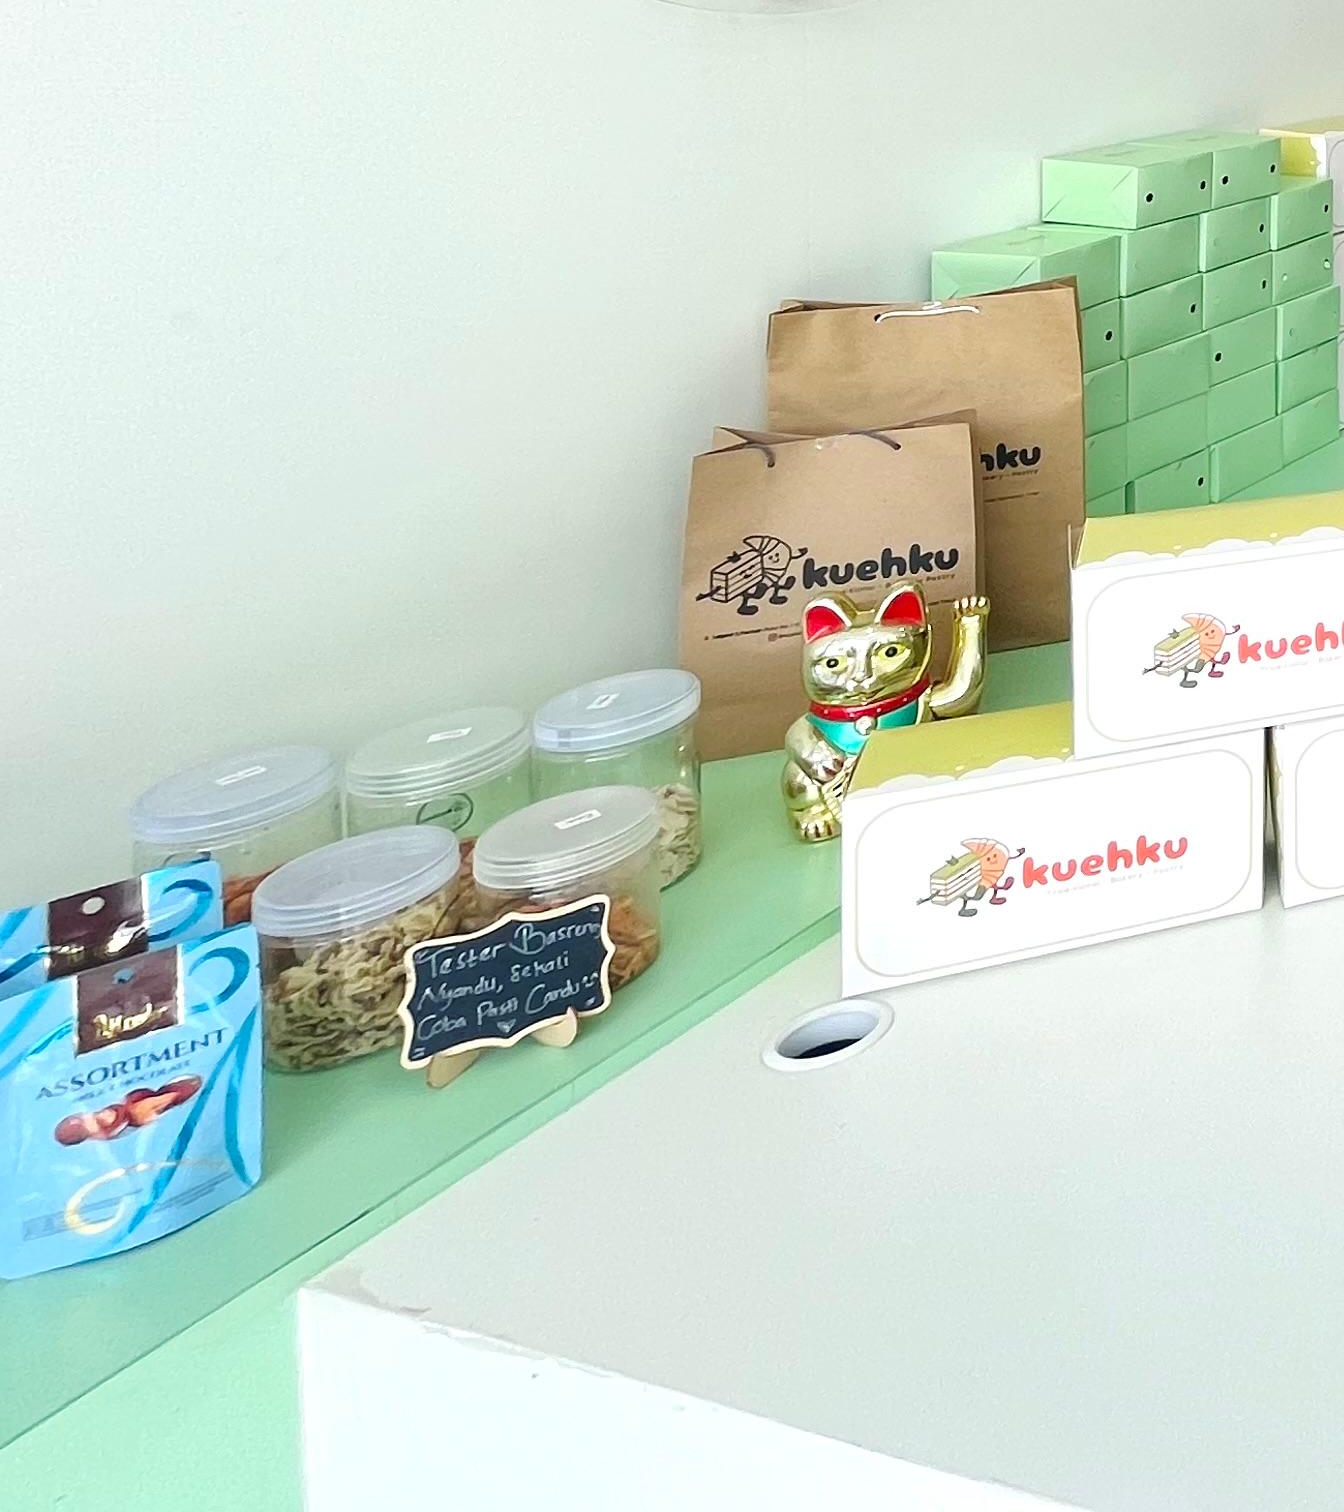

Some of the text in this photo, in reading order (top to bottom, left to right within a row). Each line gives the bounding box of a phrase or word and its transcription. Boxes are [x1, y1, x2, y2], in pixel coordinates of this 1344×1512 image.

[802, 543, 959, 590] kuehku
[1022, 834, 1189, 889] kuehku
[416, 942, 506, 978] Tester
[417, 1014, 467, 1040] Coba
[35, 1028, 227, 1101] ASSORTMENT
